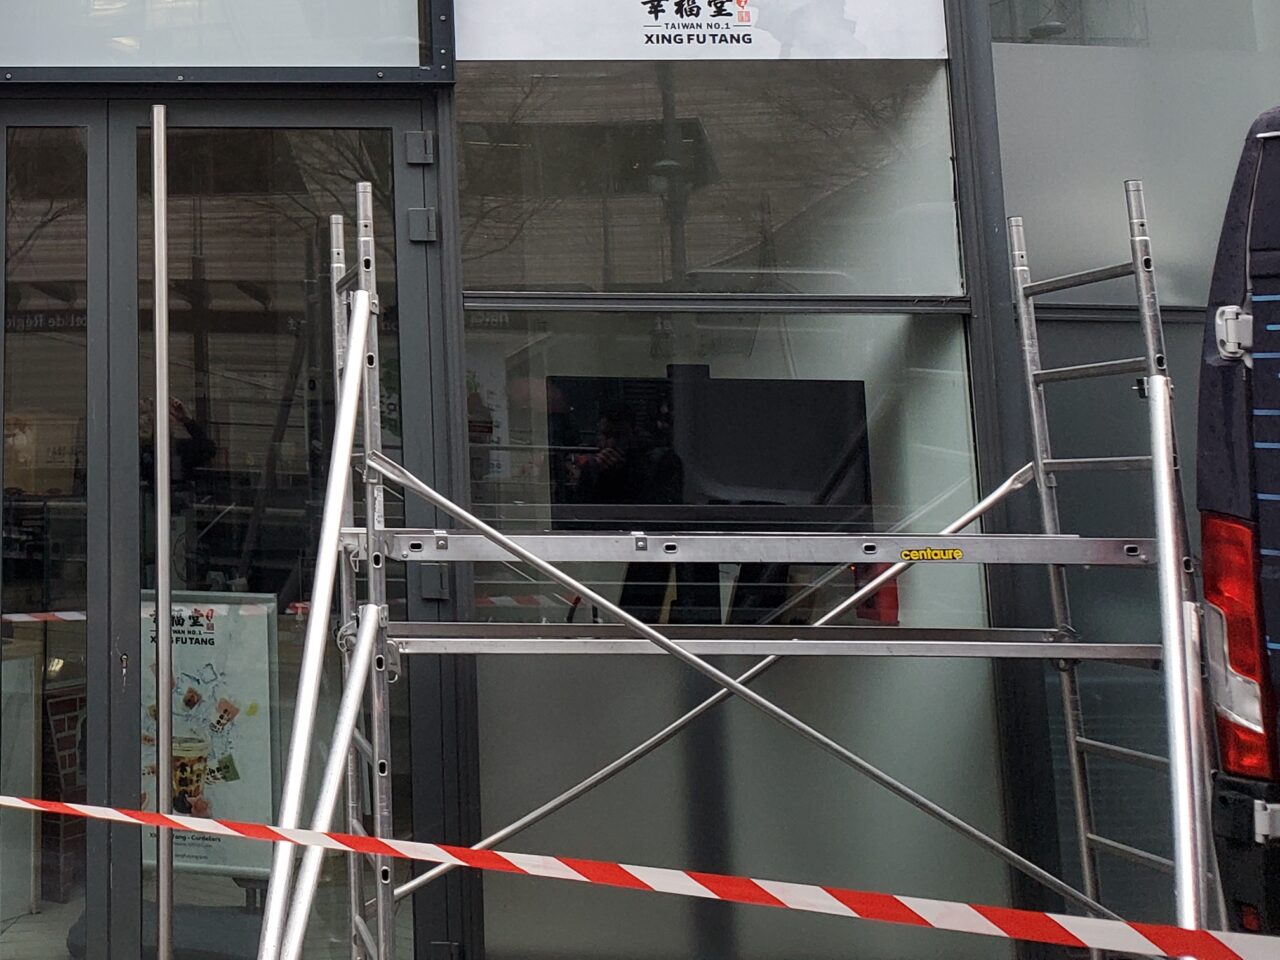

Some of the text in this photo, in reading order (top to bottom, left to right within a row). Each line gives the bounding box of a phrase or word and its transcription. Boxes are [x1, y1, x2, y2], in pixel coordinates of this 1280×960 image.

[706, 22, 731, 30] NO.1
[644, 33, 753, 45] XING FU TANG
[901, 547, 963, 560] centaure
[175, 637, 188, 645] FU
[188, 637, 215, 646] TANG
